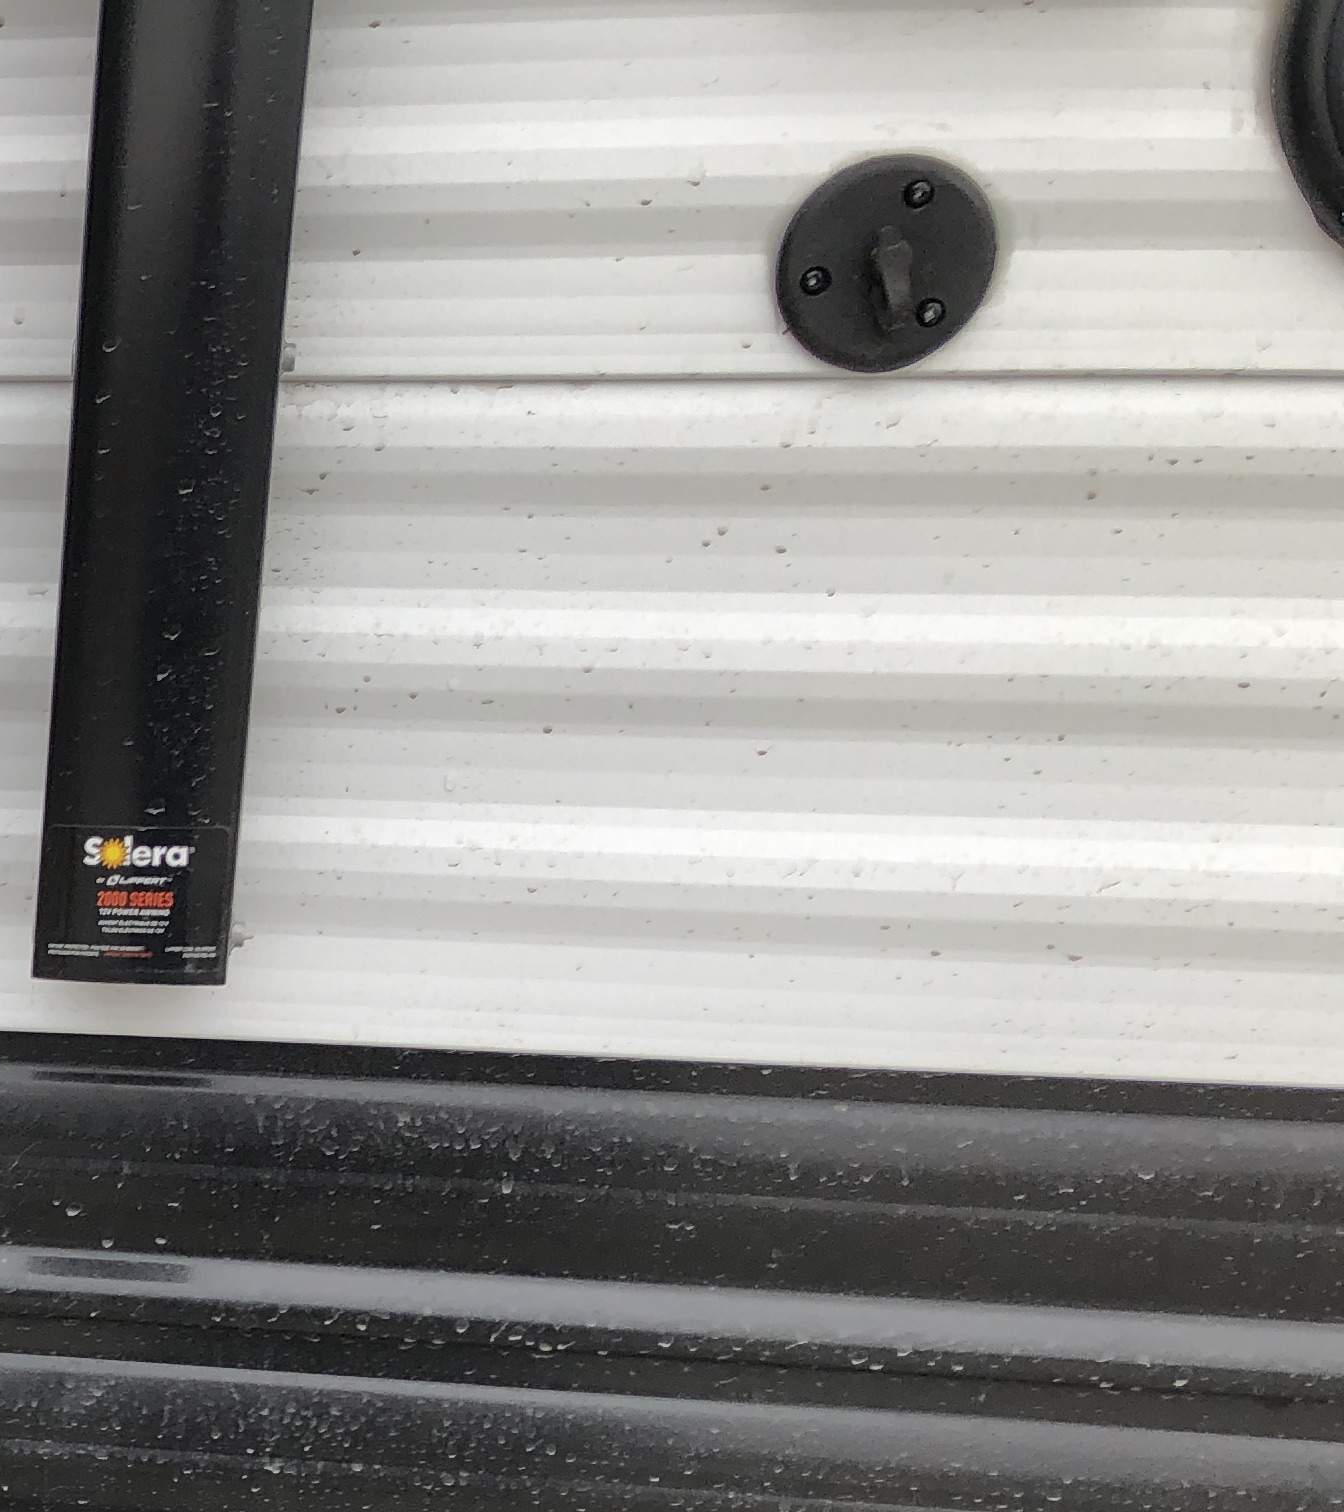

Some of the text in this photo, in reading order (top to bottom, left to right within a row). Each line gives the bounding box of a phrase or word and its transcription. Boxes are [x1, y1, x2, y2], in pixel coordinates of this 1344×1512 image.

[83, 835, 190, 869] Solera
[96, 891, 174, 907] 2000 SERIES
